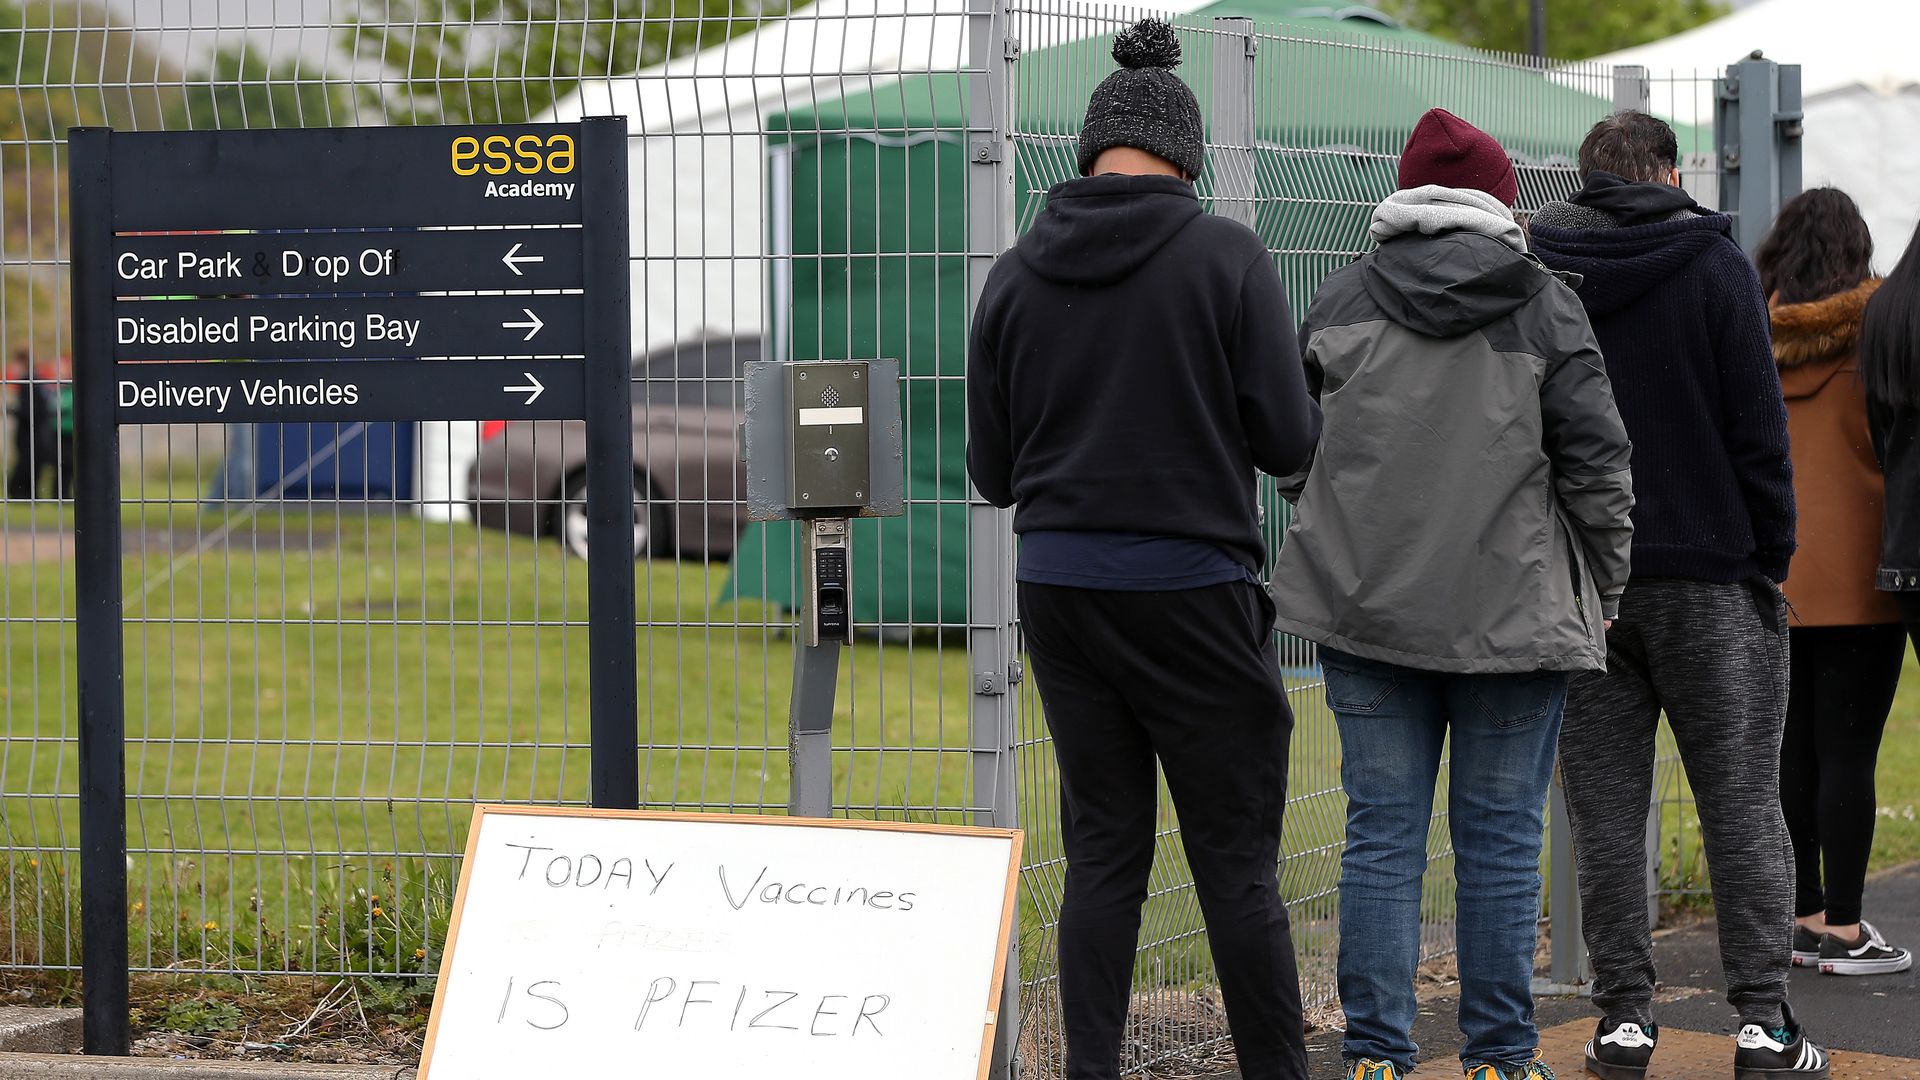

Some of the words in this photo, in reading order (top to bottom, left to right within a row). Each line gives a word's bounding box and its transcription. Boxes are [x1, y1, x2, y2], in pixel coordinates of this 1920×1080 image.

[451, 134, 575, 176] essa
[484, 180, 575, 199] Academy
[117, 252, 168, 280] Car
[178, 250, 242, 278] Park
[117, 316, 238, 345] Disabled
[249, 314, 356, 348] Parking
[366, 313, 421, 347] Bay
[118, 379, 232, 413] Delivery
[239, 378, 359, 406] Vehicles
[505, 843, 675, 894] TODAY
[718, 864, 916, 911] Vaccines
[497, 976, 570, 1031] IS
[634, 976, 891, 1037] PFIZER
